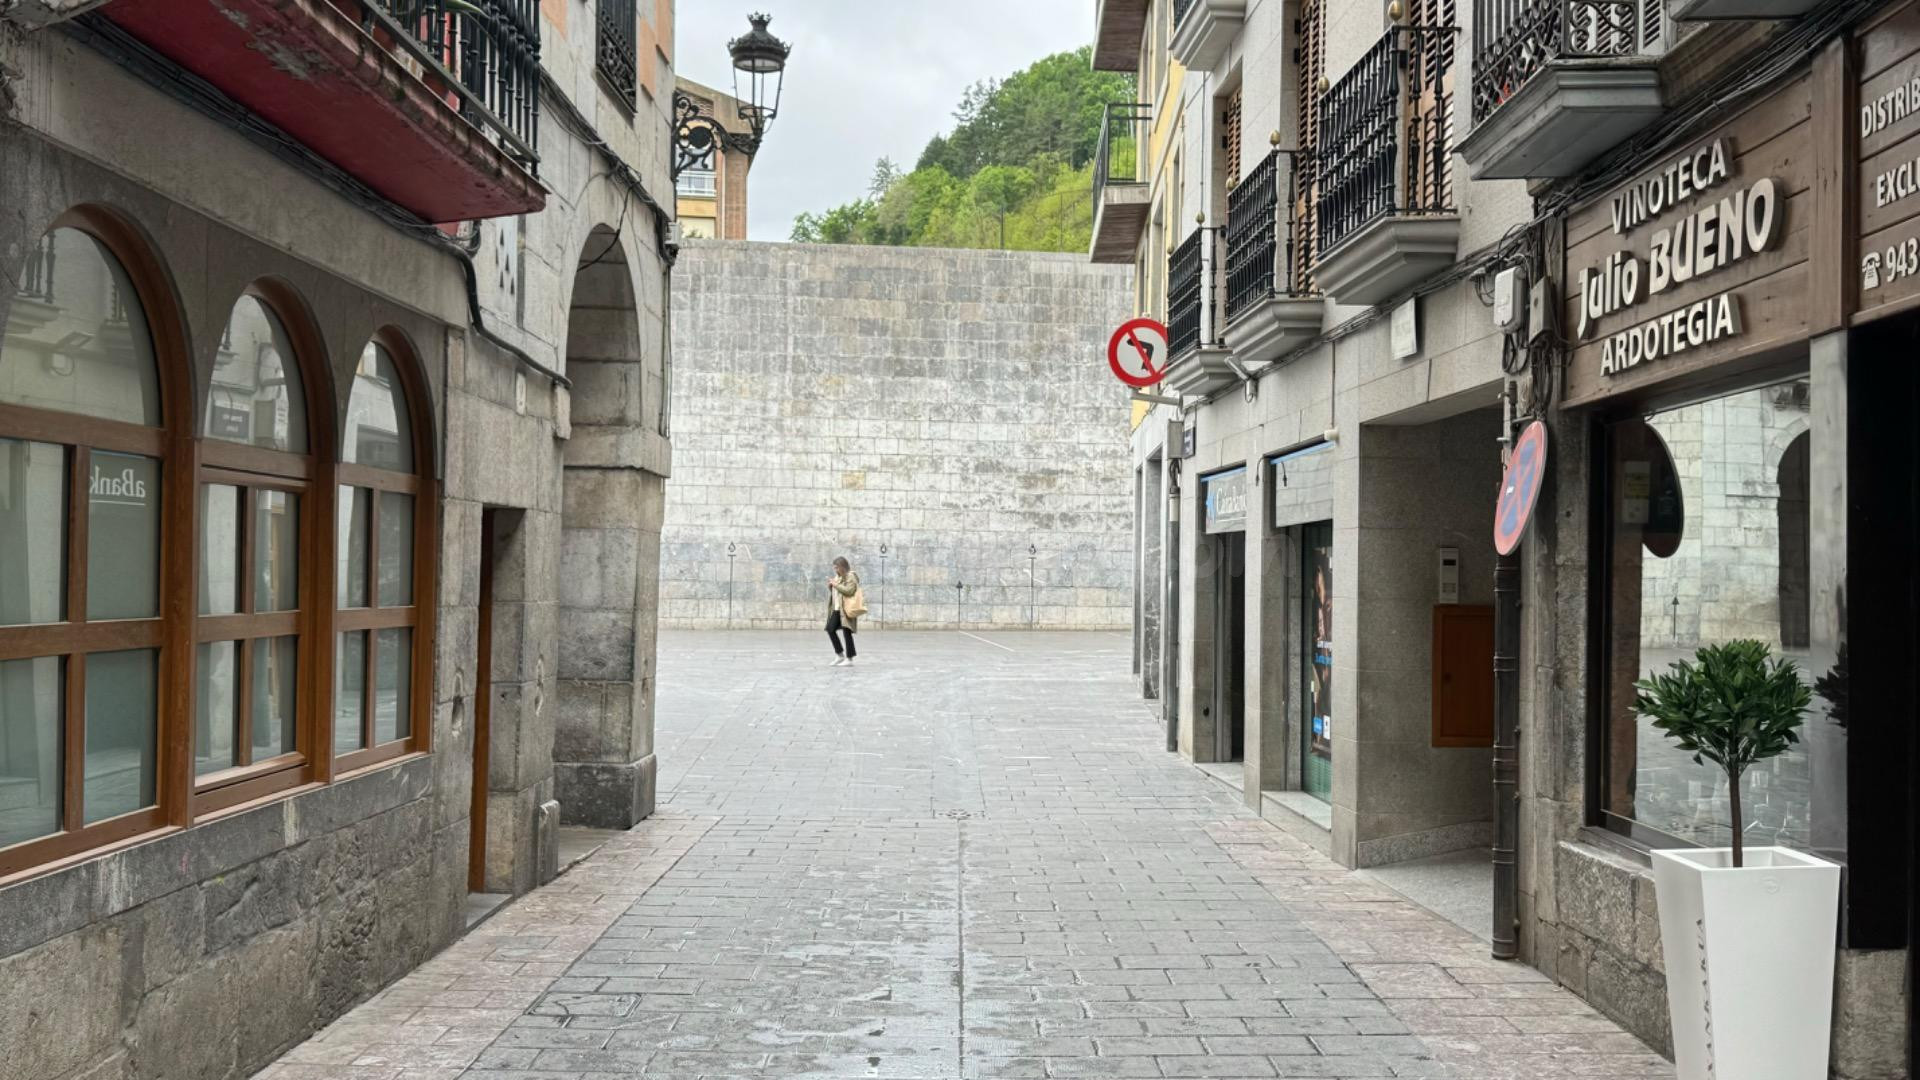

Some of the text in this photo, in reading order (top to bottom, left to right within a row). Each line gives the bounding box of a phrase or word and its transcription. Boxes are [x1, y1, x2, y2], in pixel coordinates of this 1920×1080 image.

[1611, 138, 1727, 235] VINOTECA
[1577, 178, 1775, 340] Julio BUENO
[1886, 237, 1919, 283] 943
[1600, 293, 1734, 377] ARDOTEGIA
